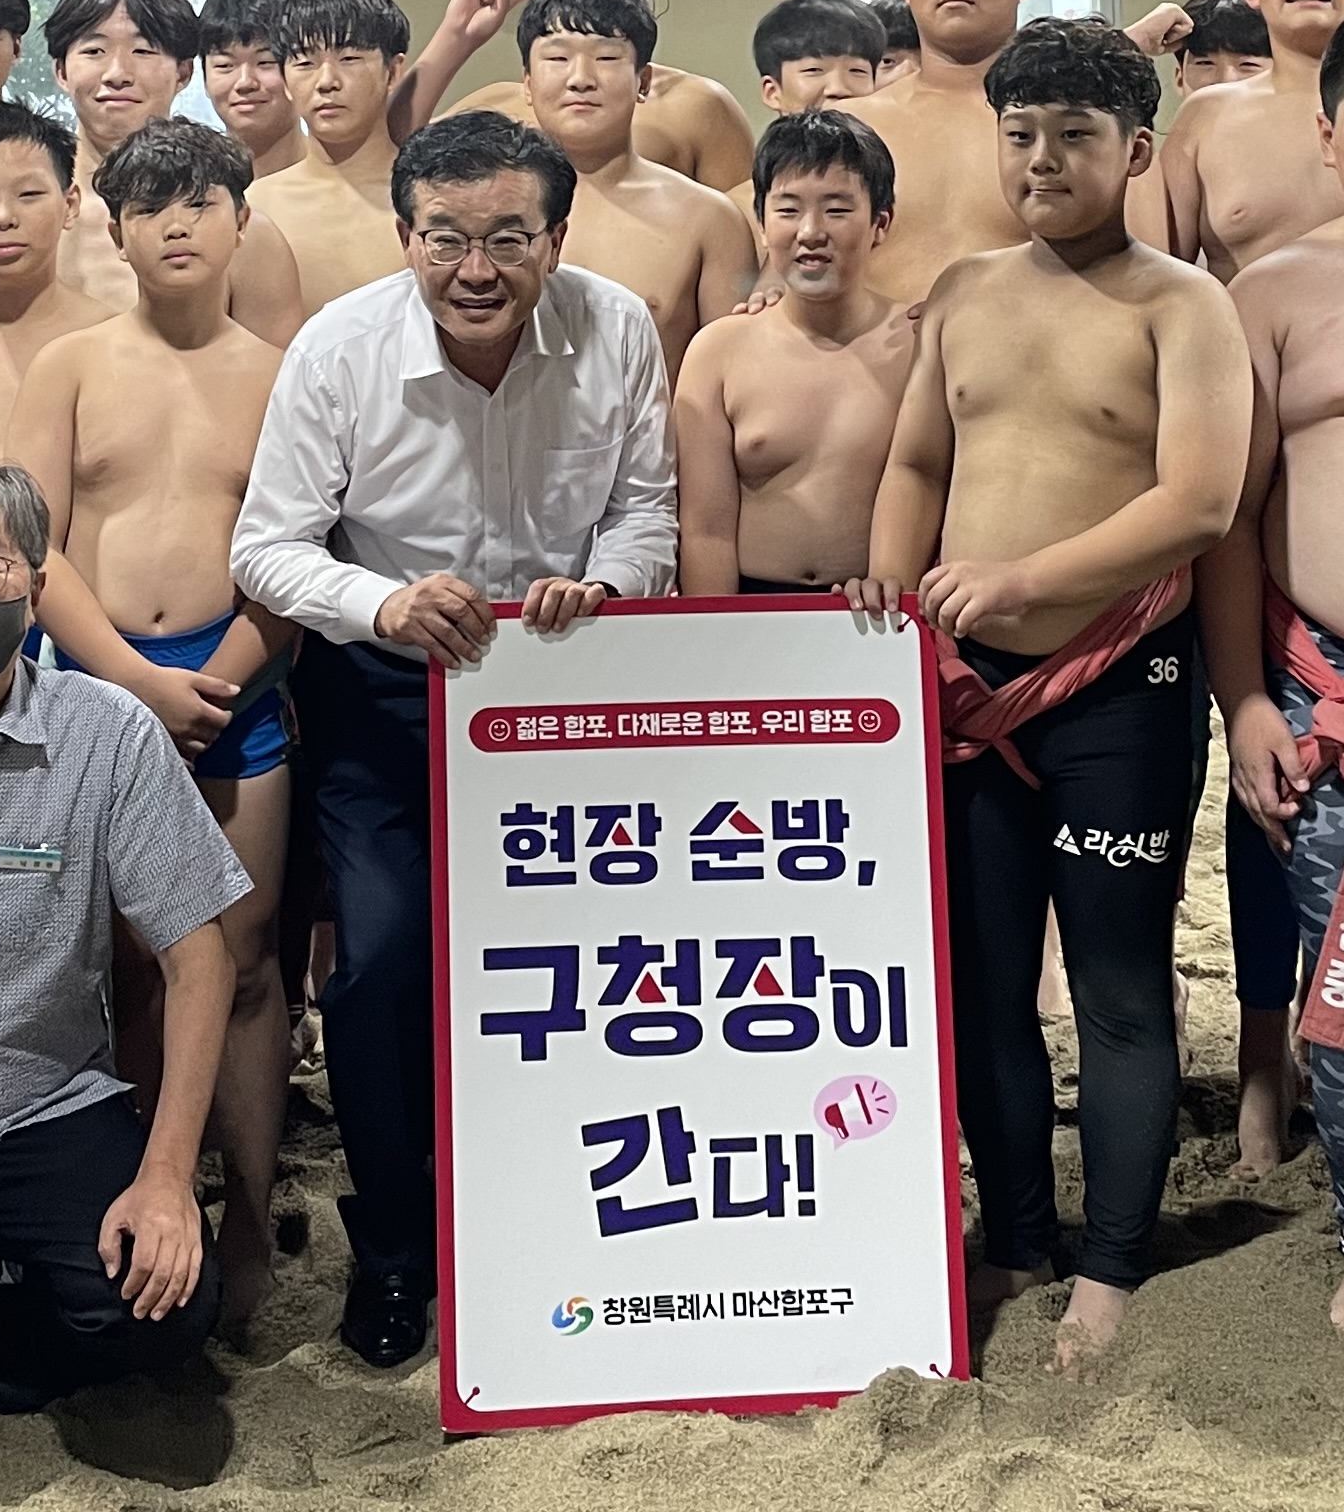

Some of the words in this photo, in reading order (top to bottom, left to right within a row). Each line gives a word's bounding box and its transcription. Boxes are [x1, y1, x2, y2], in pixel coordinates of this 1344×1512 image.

[1147, 656, 1179, 684] 36
[515, 716, 559, 741] 젊은
[563, 715, 613, 739] 합포,
[617, 713, 704, 737] 다채로운
[708, 711, 757, 736] 합포,
[761, 710, 805, 734] 우리
[809, 709, 854, 734] 합포
[500, 803, 662, 887] 현장
[688, 798, 876, 887] 순방,
[1083, 828, 1171, 867] 라쉬반
[480, 934, 910, 1062] 구청장이
[580, 1105, 817, 1238] 간다!
[602, 1292, 725, 1326] 창원특례시
[732, 1287, 854, 1318] 마산합포구
